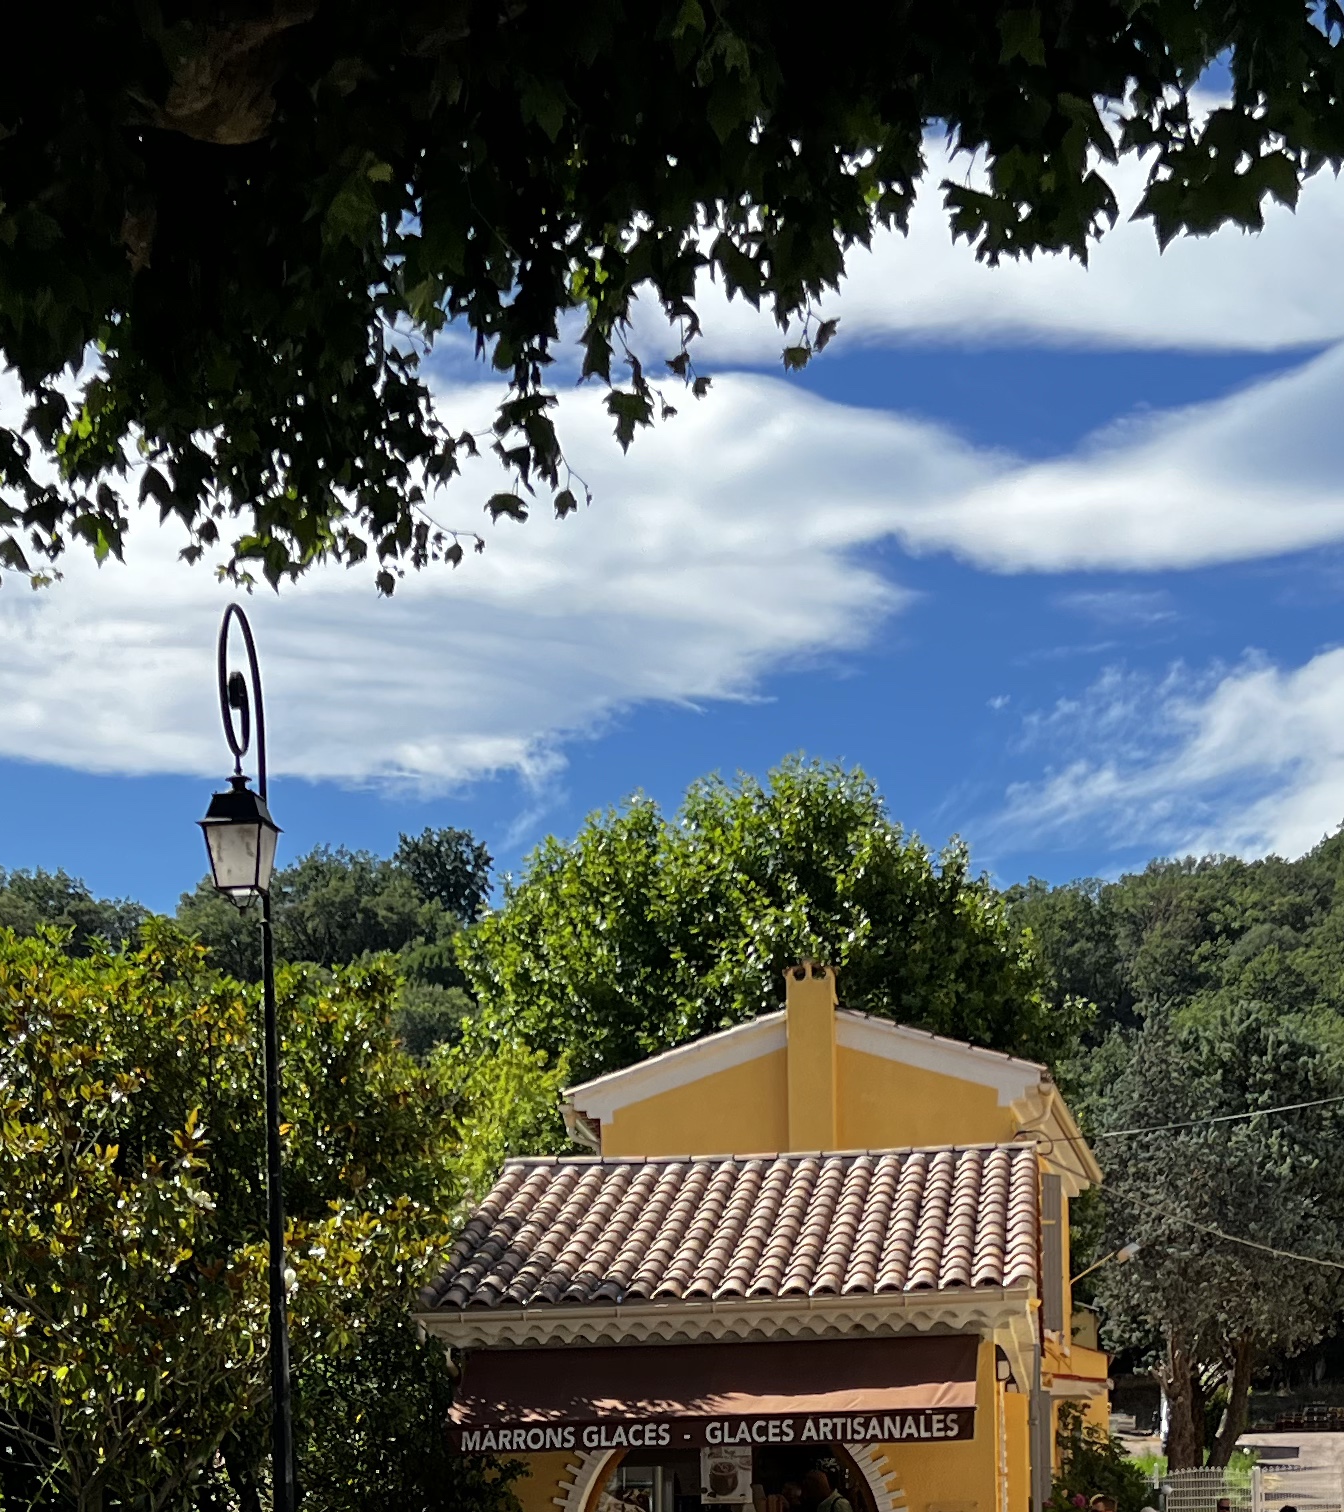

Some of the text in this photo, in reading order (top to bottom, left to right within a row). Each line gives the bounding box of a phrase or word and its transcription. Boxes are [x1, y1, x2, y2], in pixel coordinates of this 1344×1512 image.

[460, 1426, 576, 1451] MARRONS
[705, 1418, 794, 1444] GLACES
[800, 1413, 959, 1441] ARTISANALES
